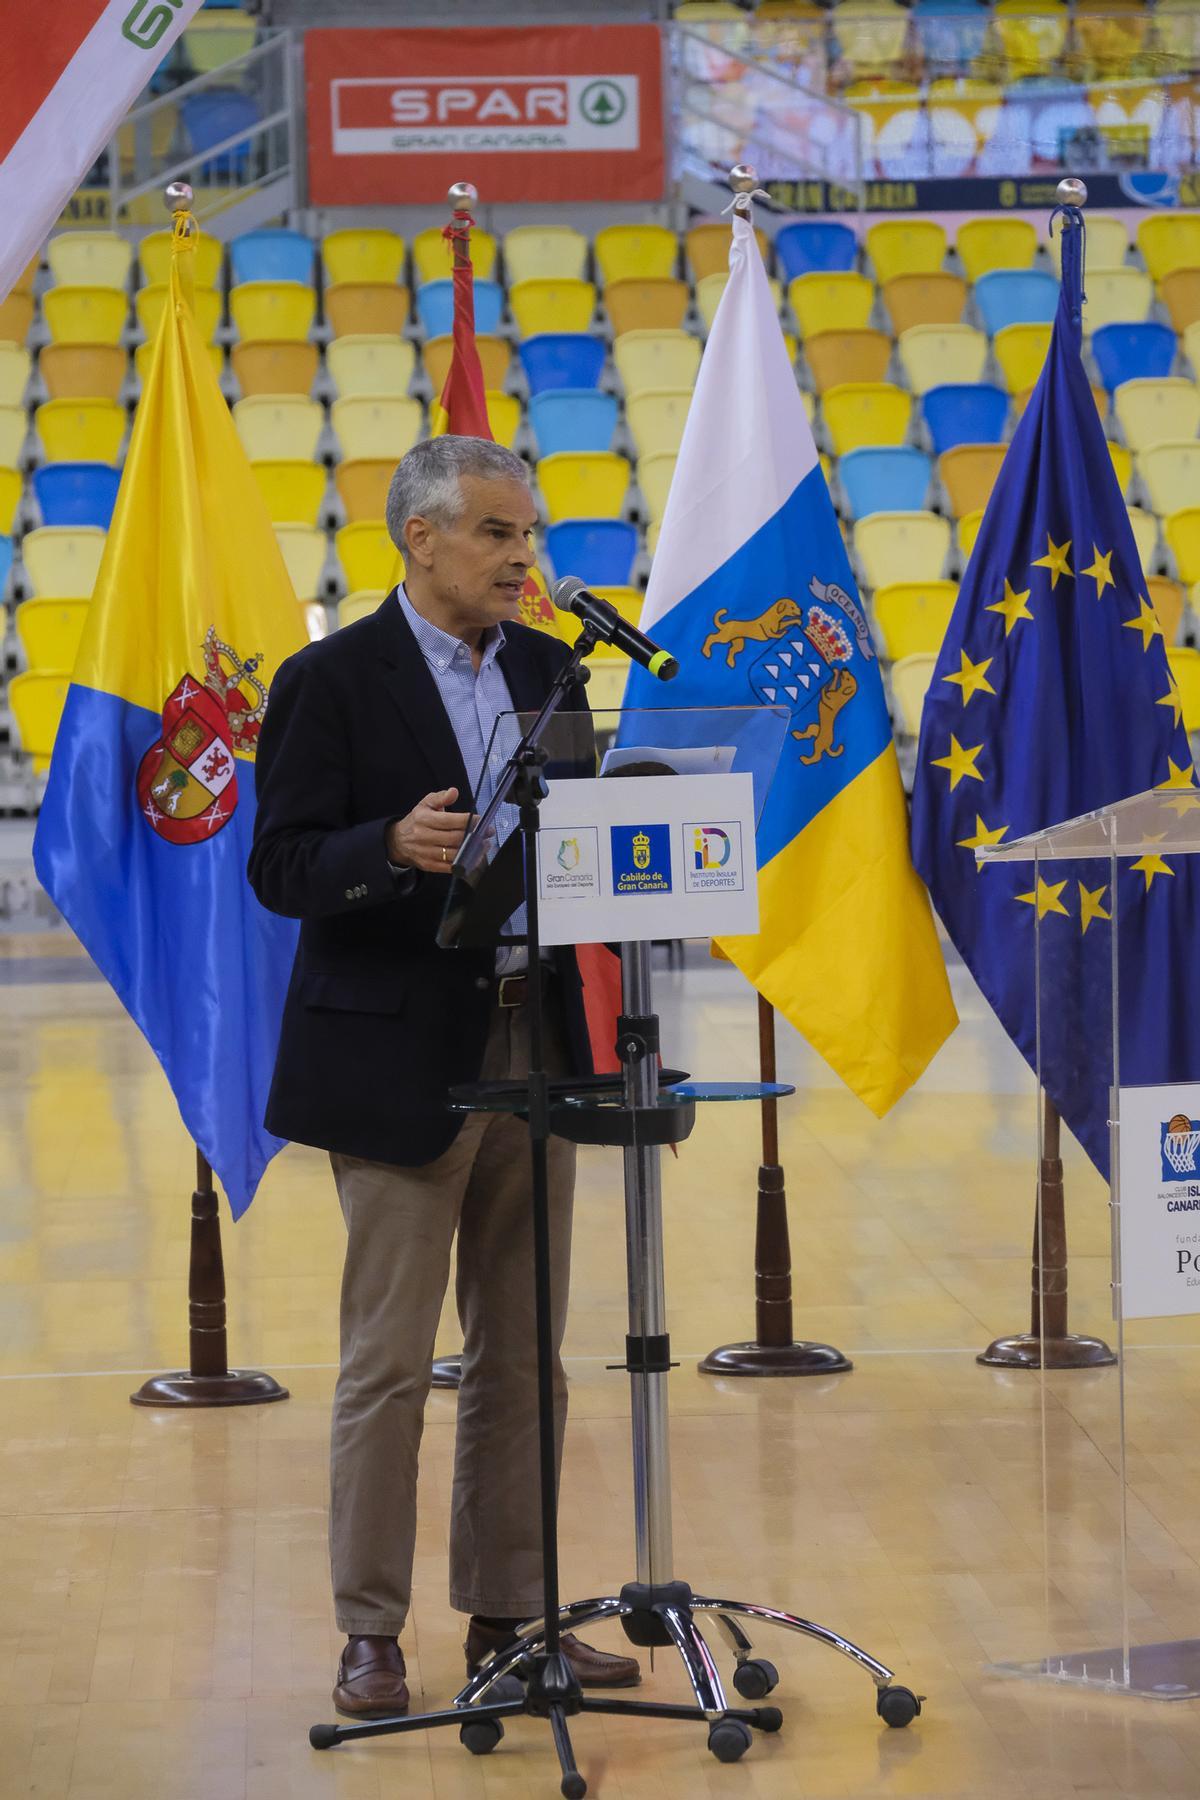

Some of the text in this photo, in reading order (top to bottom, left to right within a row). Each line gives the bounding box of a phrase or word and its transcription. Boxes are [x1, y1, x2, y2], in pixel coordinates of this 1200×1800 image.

[390, 87, 566, 122] SPAR
[392, 133, 567, 148] GRAN CANARIA
[831, 588, 866, 633] OCEANO
[620, 871, 663, 881] Cabildo de
[617, 881, 669, 891] Gran Canaria
[700, 878, 736, 887] DEPORTES
